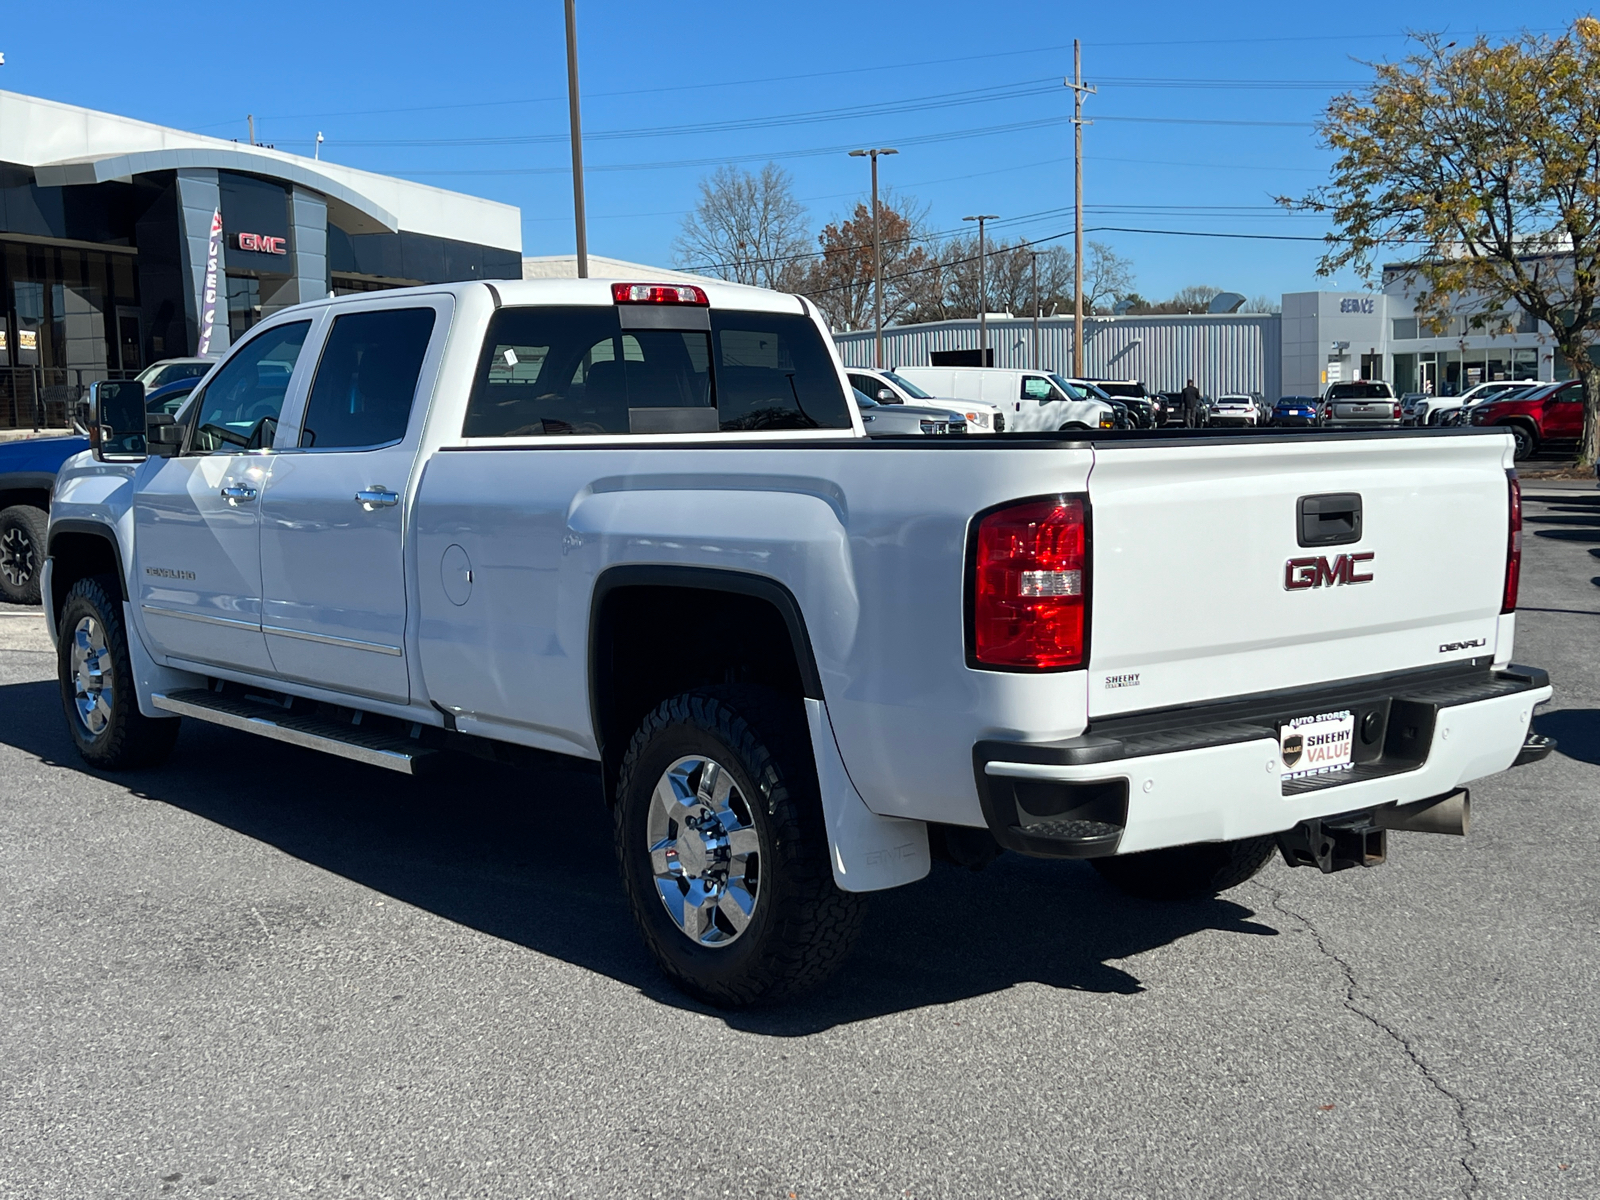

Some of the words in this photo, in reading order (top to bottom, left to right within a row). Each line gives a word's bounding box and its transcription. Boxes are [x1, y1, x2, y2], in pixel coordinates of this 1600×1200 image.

[239, 232, 287, 255] GMC
[205, 242, 218, 304] USED
[1283, 550, 1375, 592] GMC
[1438, 637, 1487, 653] DENALI
[1105, 673, 1140, 684] SHEEHY
[1289, 716, 1315, 728] AUTO
[1315, 710, 1351, 722] STORES
[1307, 729, 1351, 747] SHEEHY
[1306, 742, 1350, 762] VALUE
